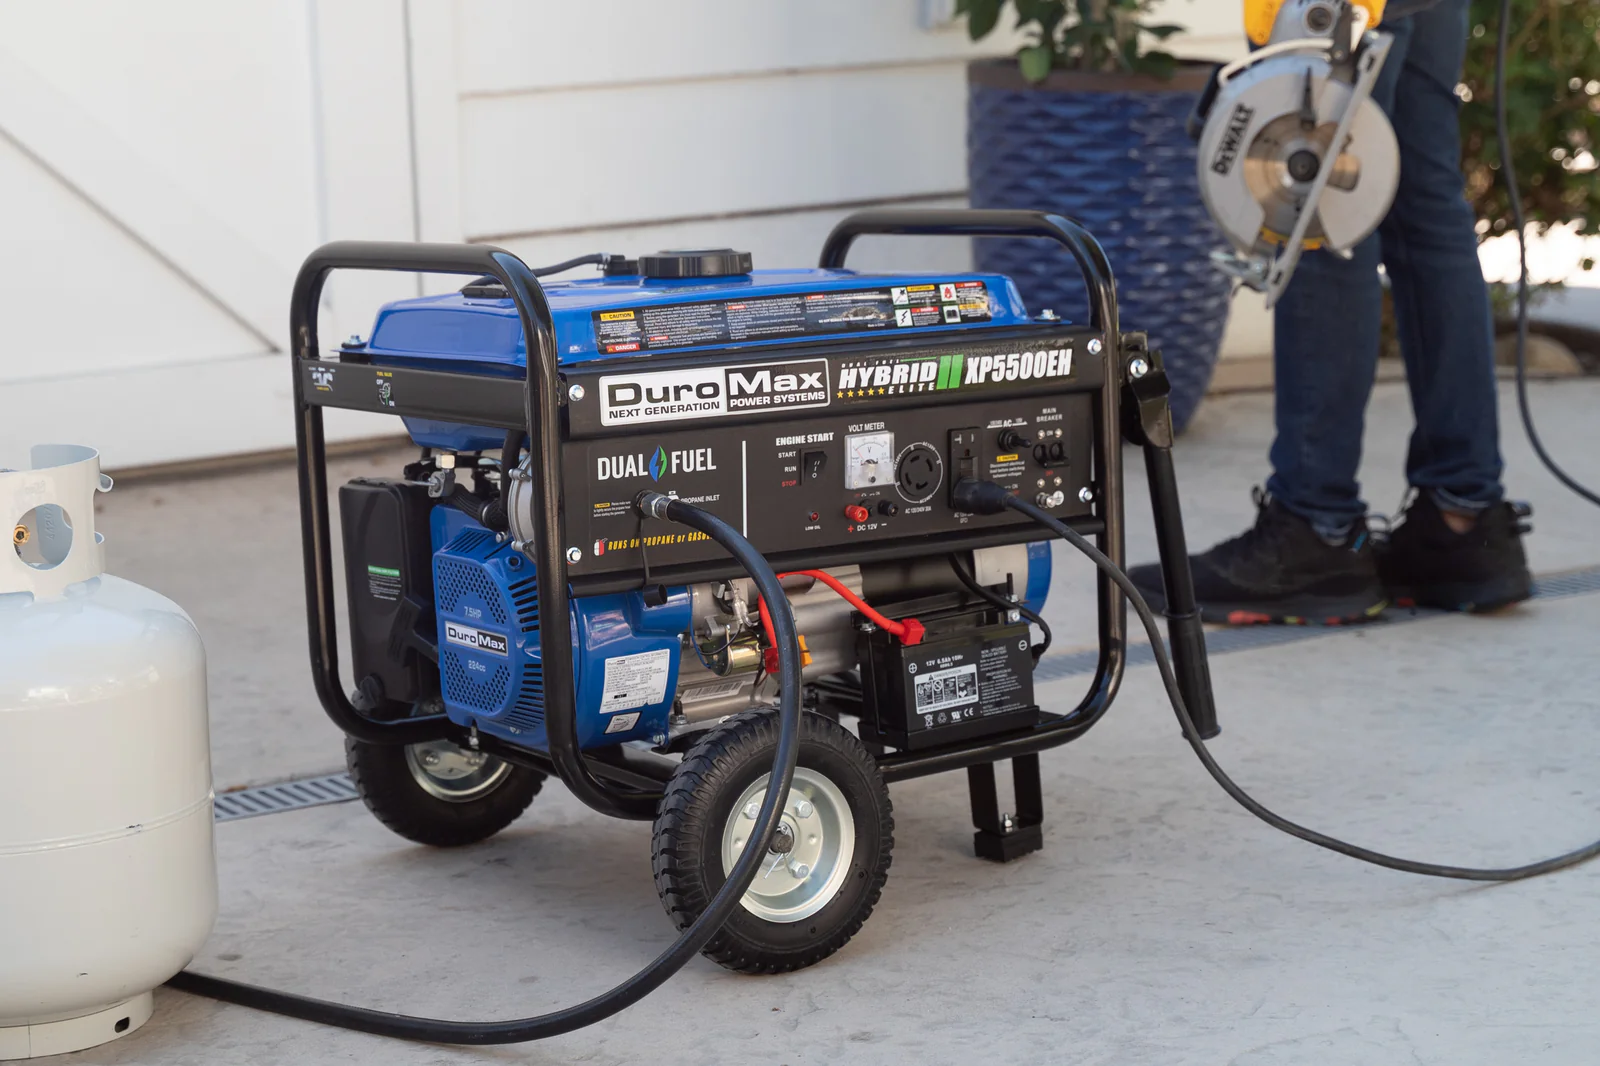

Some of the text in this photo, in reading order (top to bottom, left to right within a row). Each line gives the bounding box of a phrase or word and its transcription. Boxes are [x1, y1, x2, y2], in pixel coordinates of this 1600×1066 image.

[608, 312, 632, 320] CAUTION
[838, 361, 938, 389] HYBRID
[964, 348, 1073, 385] XP5500EH
[888, 382, 935, 395] ELITE
[730, 391, 825, 408] POWER SYSTEMS
[609, 401, 720, 419] NEXT GENERATION
[1003, 419, 1013, 427] AC
[1036, 414, 1062, 422] BREAKER
[848, 422, 885, 432] VOLT METER
[775, 432, 835, 446] ENGINE START
[597, 447, 717, 480] DUAL FUEL
[857, 524, 866, 532] DC
[608, 539, 627, 550] RUNS
[630, 538, 640, 548] ON
[677, 535, 686, 543] or
[464, 606, 482, 619] 7.5HP
[468, 660, 486, 672] 224cc
